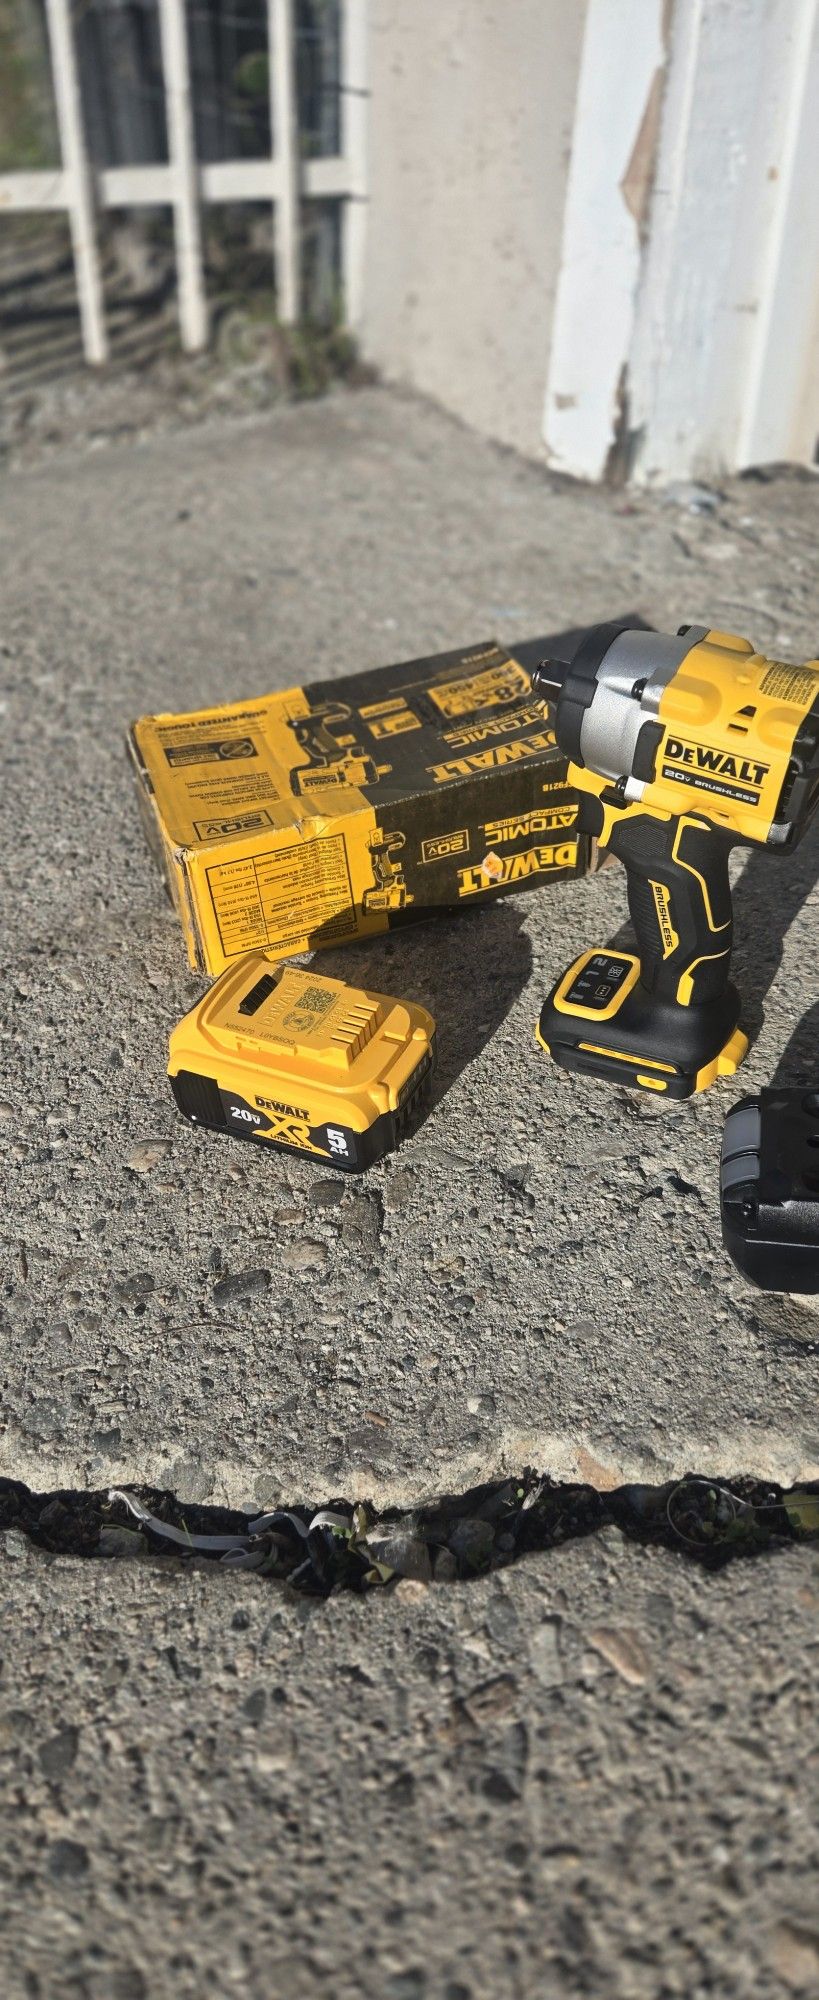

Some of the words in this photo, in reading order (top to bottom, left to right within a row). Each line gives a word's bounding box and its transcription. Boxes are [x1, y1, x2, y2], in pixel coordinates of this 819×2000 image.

[447, 700, 549, 749] ATOMIC
[664, 738, 769, 785] DEWALT
[694, 780, 757, 803] BRUSHLESS
[492, 815, 526, 828] SERIES
[528, 805, 571, 820] COMPACT
[485, 813, 579, 846] ATOMIC
[428, 839, 464, 856] 20V
[655, 886, 673, 947] BRUSHLESS
[230, 1106, 260, 1125] 20V
[255, 1096, 310, 1120] DEWALT
[254, 1112, 333, 1158] XR
[270, 1133, 298, 1147] LITHIUM
[327, 1128, 347, 1150] 5
